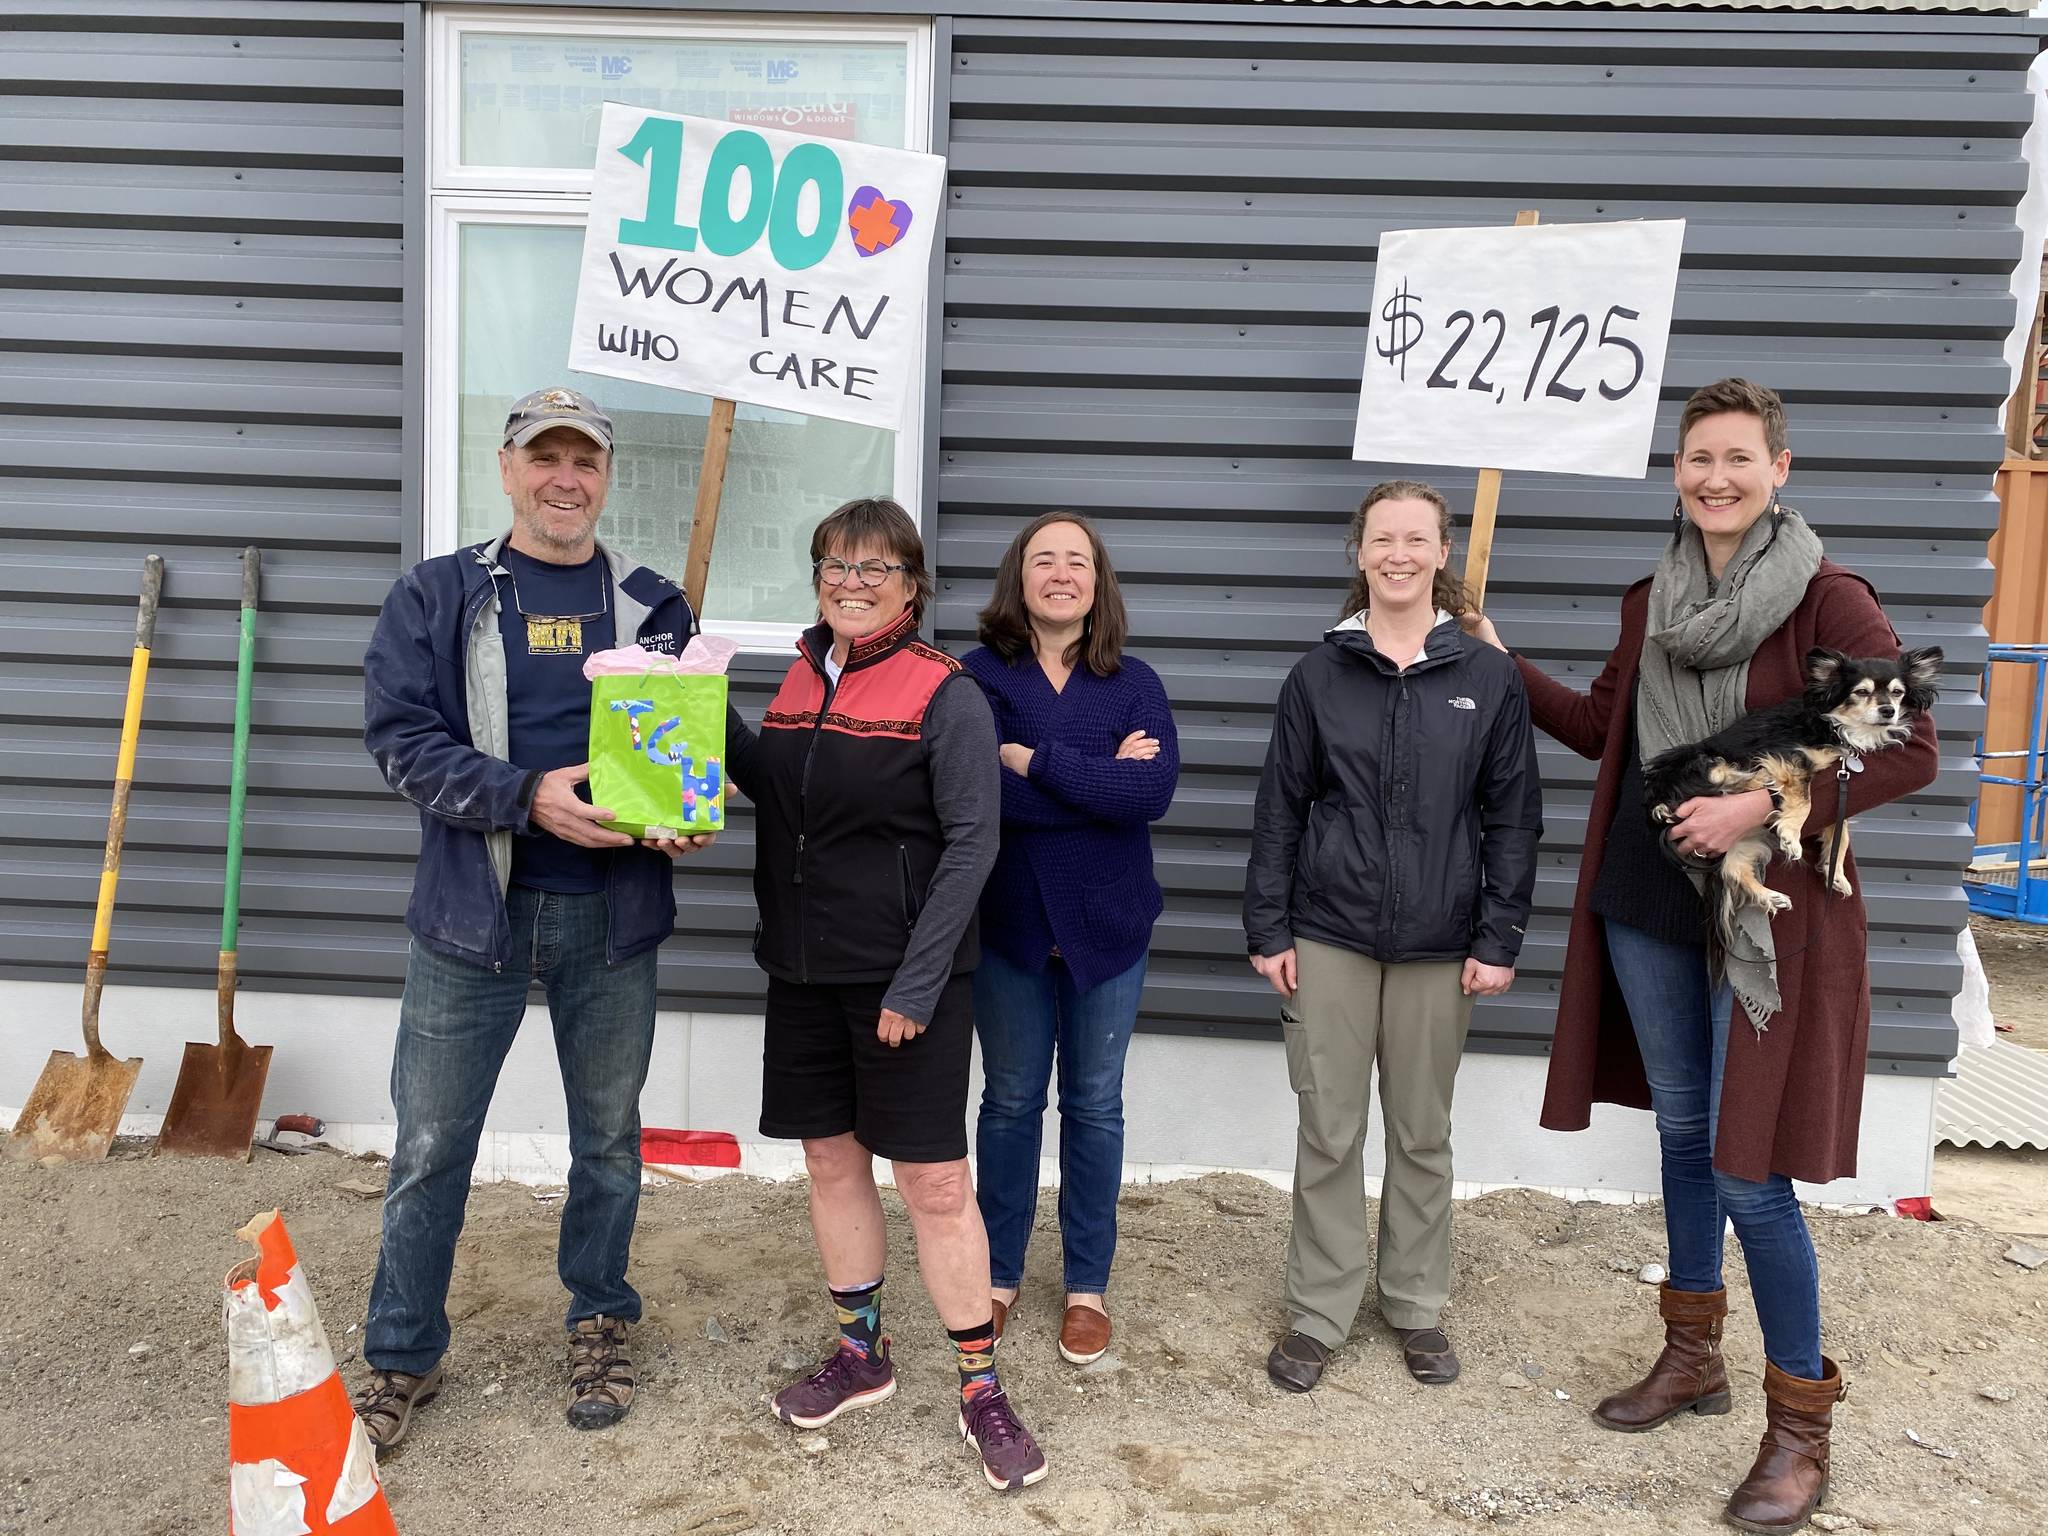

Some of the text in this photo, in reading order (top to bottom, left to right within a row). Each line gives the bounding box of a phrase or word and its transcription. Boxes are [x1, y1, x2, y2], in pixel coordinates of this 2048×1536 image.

[617, 116, 843, 271] 100
[609, 251, 890, 340] WOMEN
[598, 323, 879, 401] WHO CARE
[639, 632, 674, 645] ANCHOR
[644, 641, 676, 651] CTRIC
